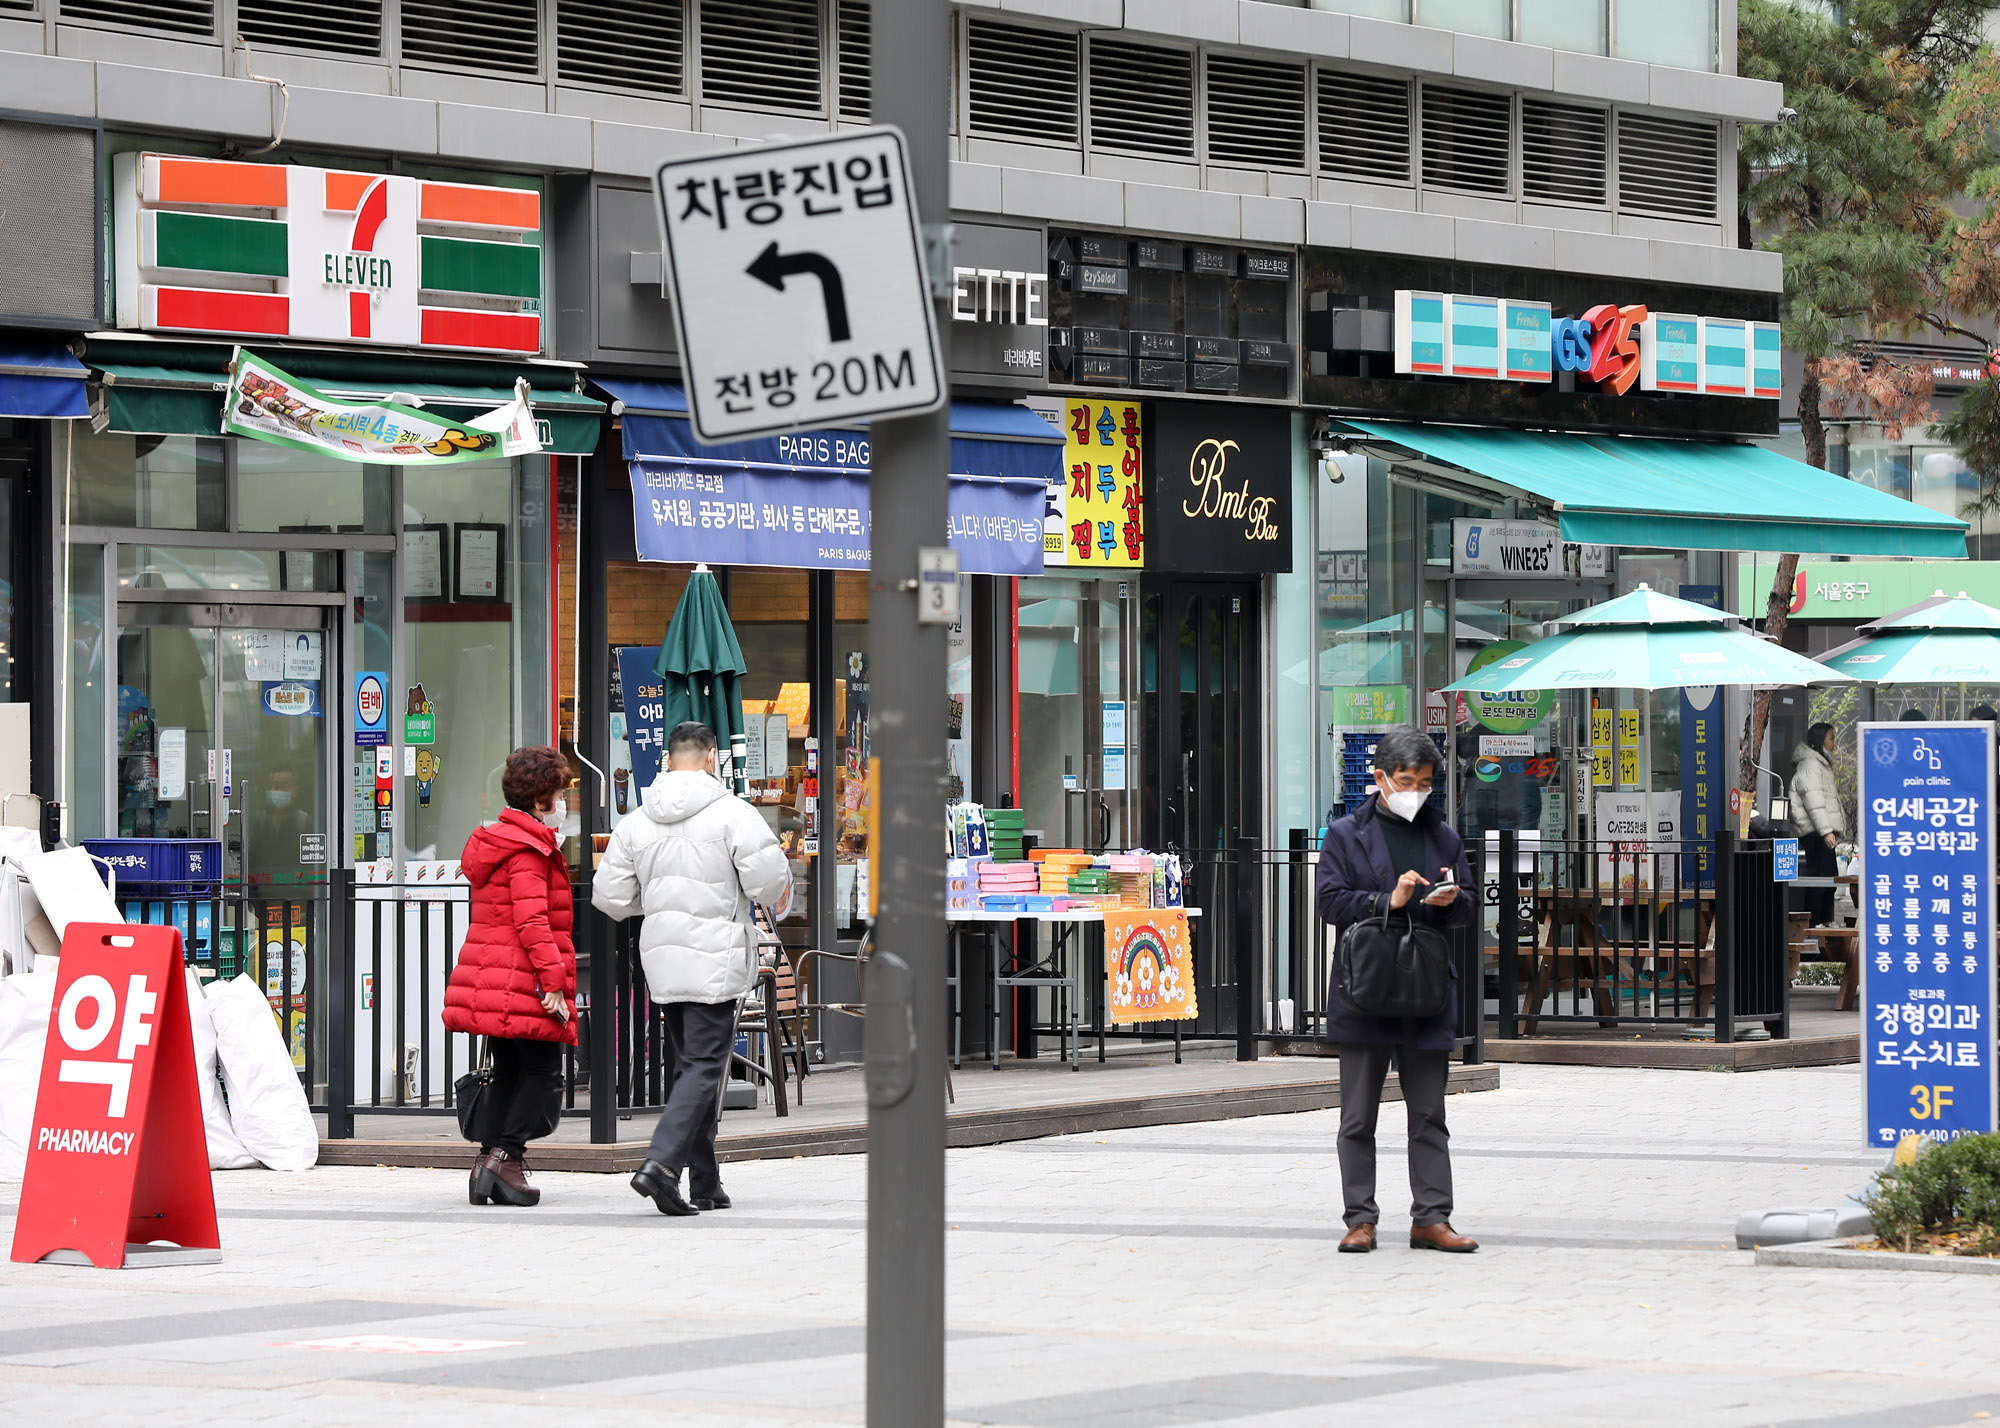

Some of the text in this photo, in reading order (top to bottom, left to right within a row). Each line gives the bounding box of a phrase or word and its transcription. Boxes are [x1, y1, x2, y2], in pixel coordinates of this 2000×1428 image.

[676, 152, 894, 230] 차량진입
[1060, 260, 1070, 276] 2F
[1248, 258, 1288, 273] 마이크로스튜디오
[1084, 269, 1116, 286] ezySalad
[1517, 311, 1540, 330] Friendly
[1061, 330, 1070, 347] B1
[1519, 333, 1537, 348] Fresh
[1665, 324, 1687, 344] Friendly
[1003, 348, 1042, 368] 파리바게뜨
[1522, 353, 1535, 368] Fun
[1553, 304, 1647, 397] GS25
[1083, 360, 1111, 373] BMT BAR
[715, 349, 916, 414] 전방 20M
[335, 412, 371, 436] 도시락
[370, 415, 400, 445] 4종
[778, 435, 871, 465] PARIS BAG
[646, 471, 724, 493] 파리바게뜨 무교점
[1070, 404, 1092, 560] 김치찜
[1096, 406, 1117, 560] 순두부
[1121, 407, 1144, 561] 홍어삼합
[651, 499, 697, 528] 유치원,
[699, 501, 760, 531] 공공기관,
[763, 504, 788, 531] 회사
[791, 505, 805, 533] 등
[807, 507, 865, 536] 단체주문,
[983, 515, 1043, 543] (배달가능)
[818, 547, 844, 560] PARIS
[1814, 582, 1871, 601] 서울중구
[247, 634, 268, 649] 마스크
[1553, 668, 1617, 683] Fresh
[1673, 664, 1769, 682] Friendly
[1930, 665, 1990, 676] Fresh
[361, 691, 380, 709] 담배
[1427, 708, 1446, 724] USIM
[1482, 707, 1537, 718] 로또 판매점
[1592, 717, 1637, 742] 삼성 카드
[1507, 756, 1558, 779] GS25
[1621, 763, 1635, 782] 1+1
[1577, 769, 1585, 803] 당기시오
[1903, 776, 1951, 788] pain clinic
[751, 787, 783, 799] @pb_mugyo
[1696, 719, 1708, 871] 로또판매점
[1872, 797, 1979, 828] 연세공감
[806, 842, 817, 851] VISA
[1873, 830, 1979, 857] 통증의학과
[1874, 874, 1893, 973] 골반통증
[1903, 874, 1921, 973] 무릎통증
[1931, 875, 1951, 974] 어깨통증
[1141, 931, 1154, 941] THE
[1908, 989, 1946, 1001] 진료과목
[1874, 1003, 1981, 1036] 정형외과
[57, 974, 158, 1119] 약
[1875, 1040, 1981, 1071] 도수치료
[1909, 1084, 1954, 1120] 3F
[37, 1127, 134, 1157] PHARMACY
